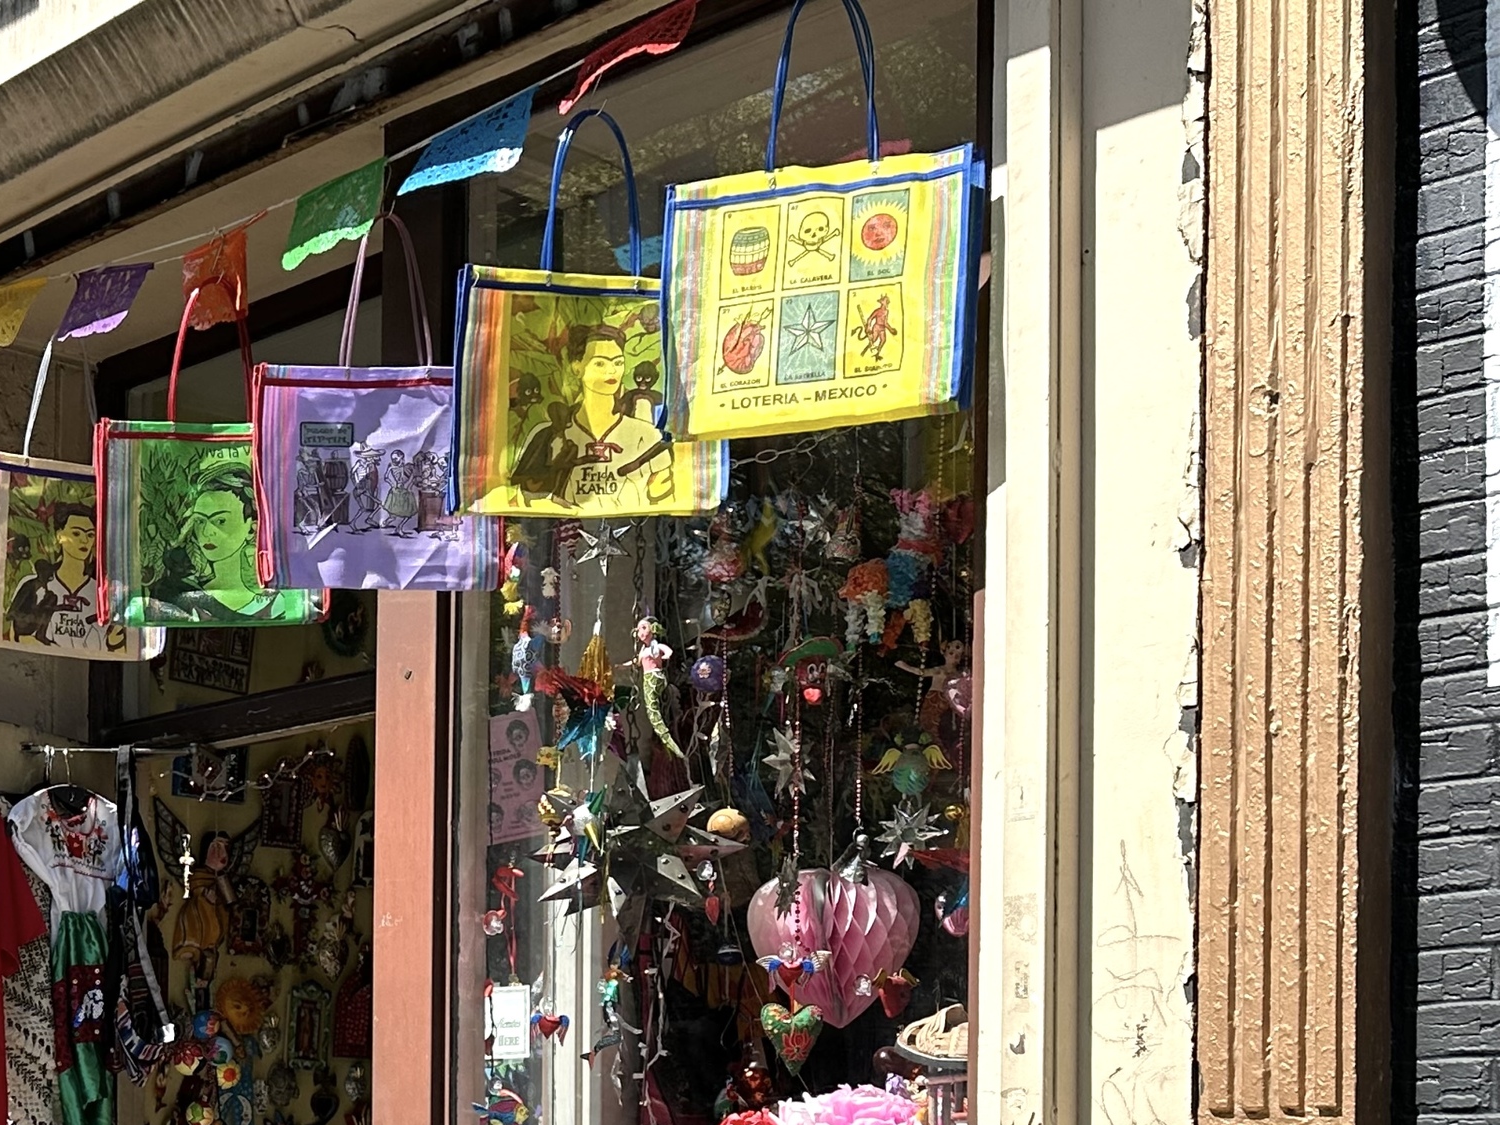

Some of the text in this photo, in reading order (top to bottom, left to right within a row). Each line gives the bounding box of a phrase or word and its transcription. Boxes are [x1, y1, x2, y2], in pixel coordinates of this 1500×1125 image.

[800, 274, 833, 284] CALAVERA
[731, 392, 799, 410] LOTERIA
[814, 383, 878, 402] MEXICO
[194, 447, 223, 460] Viva
